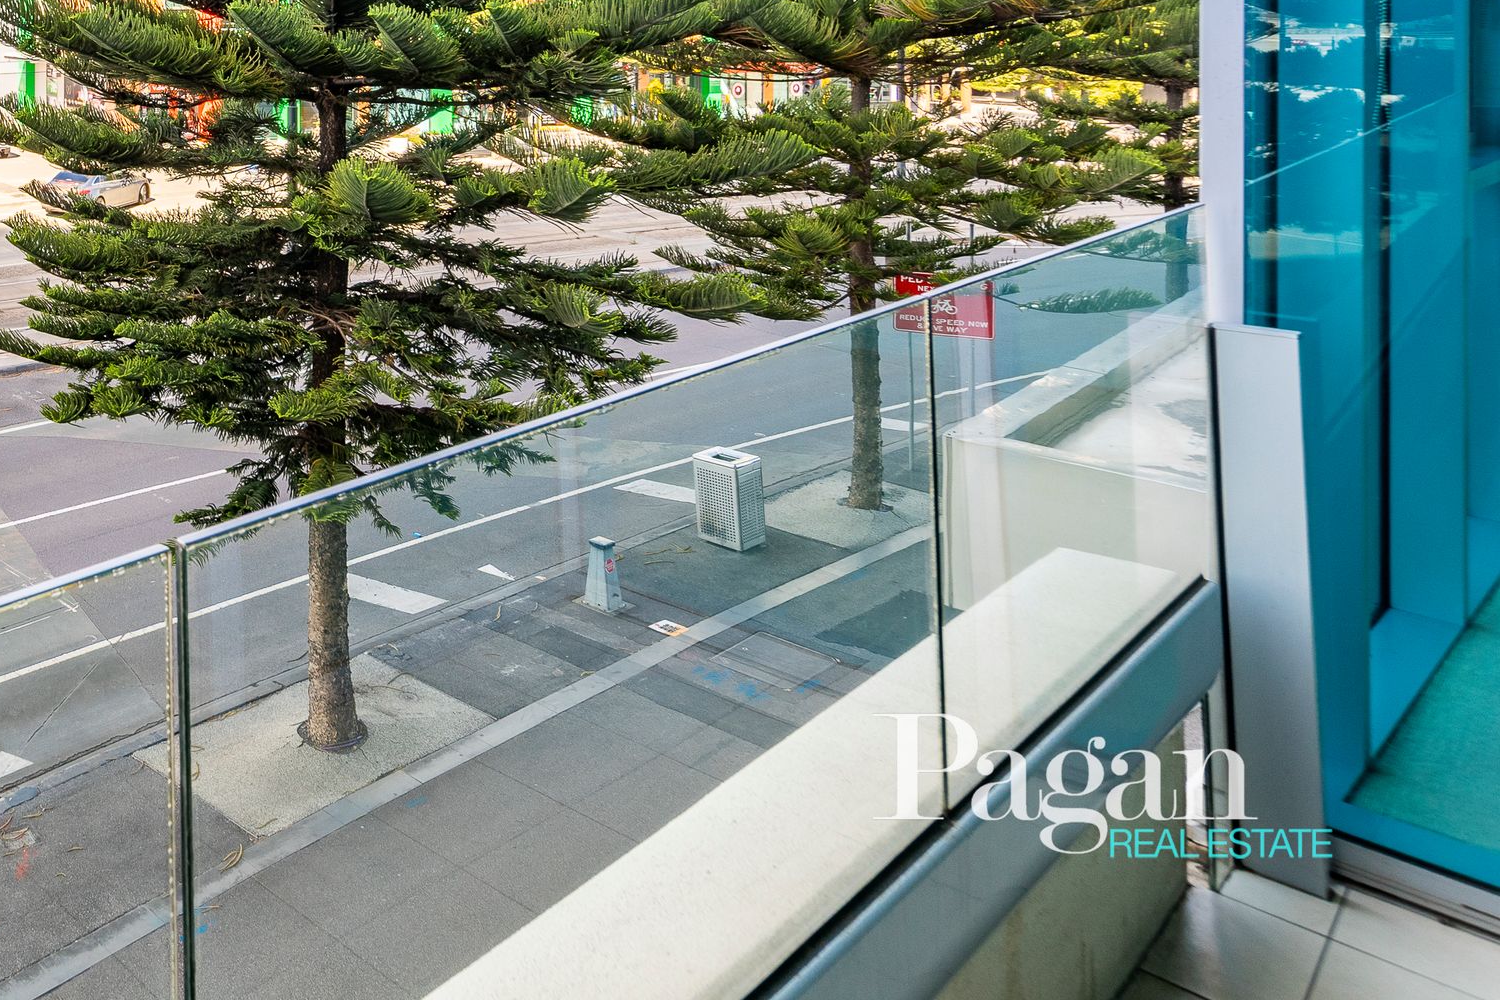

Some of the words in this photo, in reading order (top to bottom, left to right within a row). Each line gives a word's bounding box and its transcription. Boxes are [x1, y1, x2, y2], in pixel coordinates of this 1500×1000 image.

[917, 285, 936, 293] NEX
[899, 314, 927, 322] REDU
[935, 318, 965, 327] SPEED
[967, 320, 989, 329] NOW
[946, 326, 969, 334] WAY
